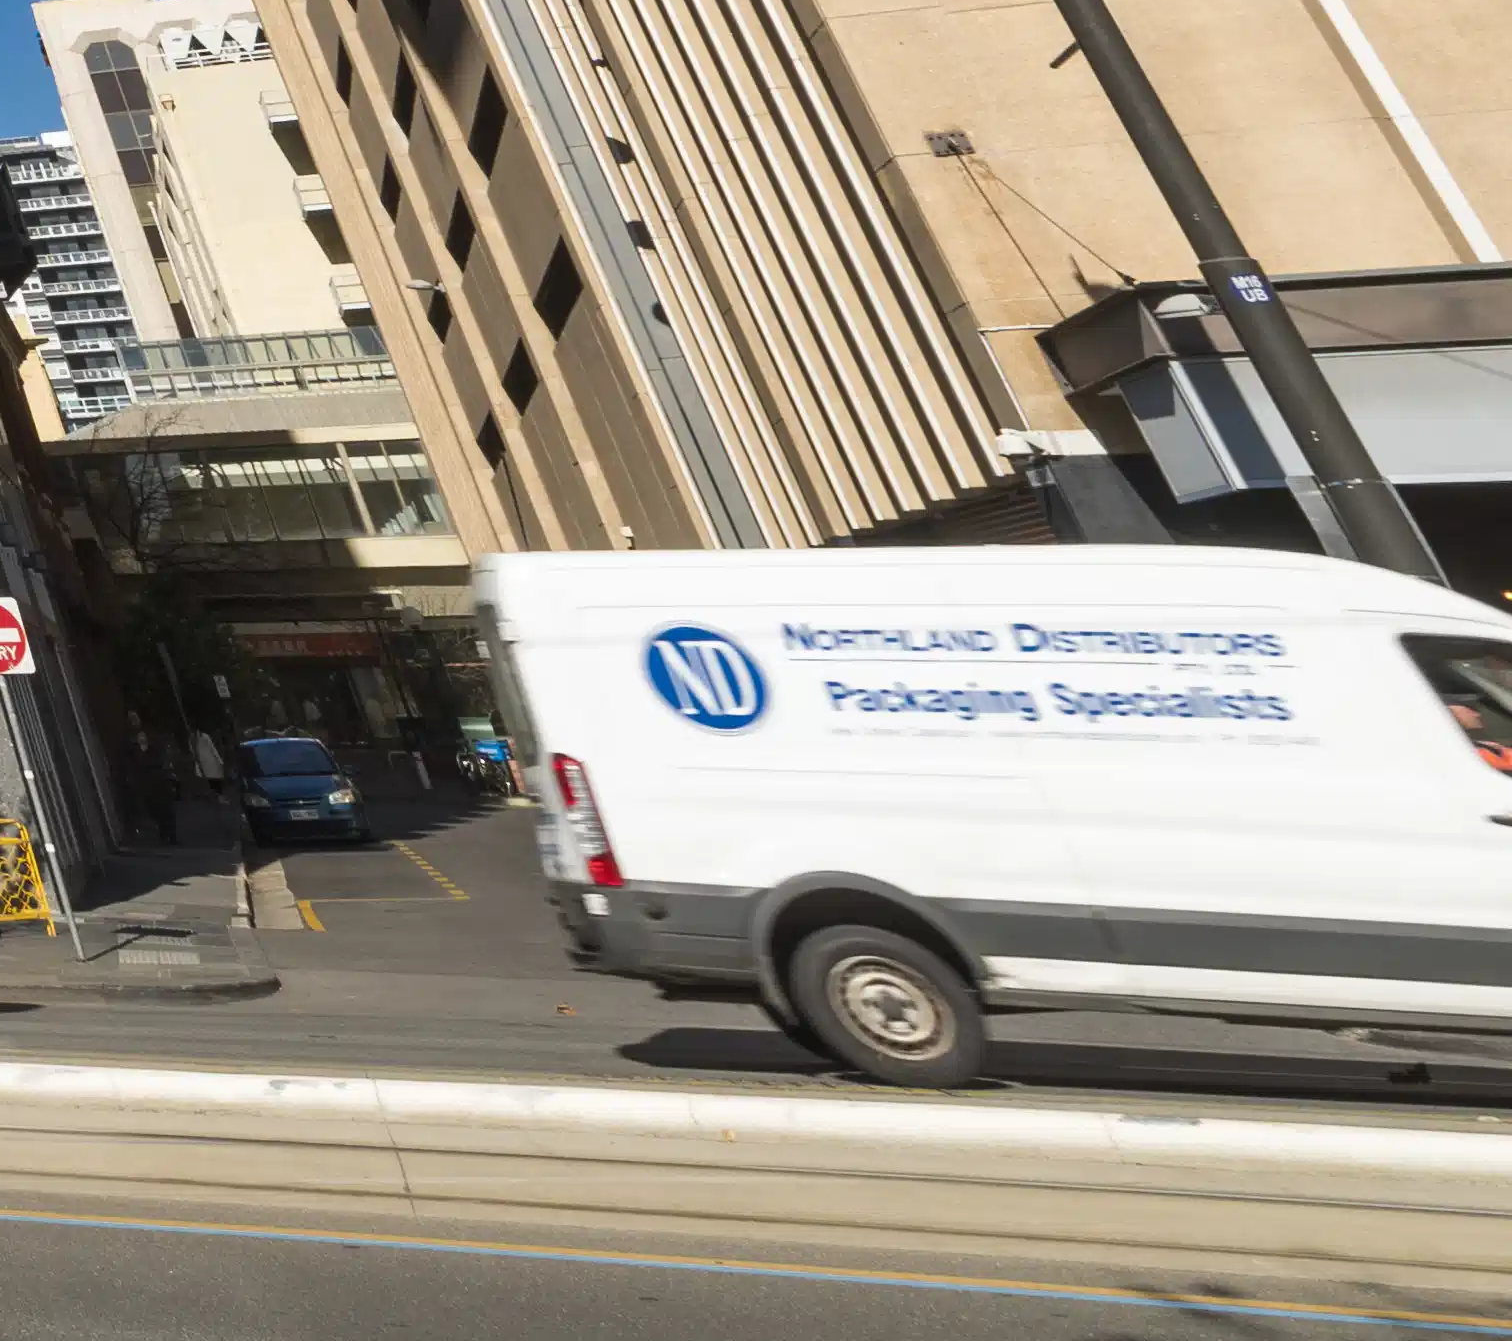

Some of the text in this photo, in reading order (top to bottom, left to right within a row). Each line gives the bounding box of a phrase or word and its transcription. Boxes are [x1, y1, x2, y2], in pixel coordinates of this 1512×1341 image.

[1240, 288, 1270, 302] UB
[650, 639, 760, 717] ND
[824, 680, 1295, 724] Packaging Specialists
